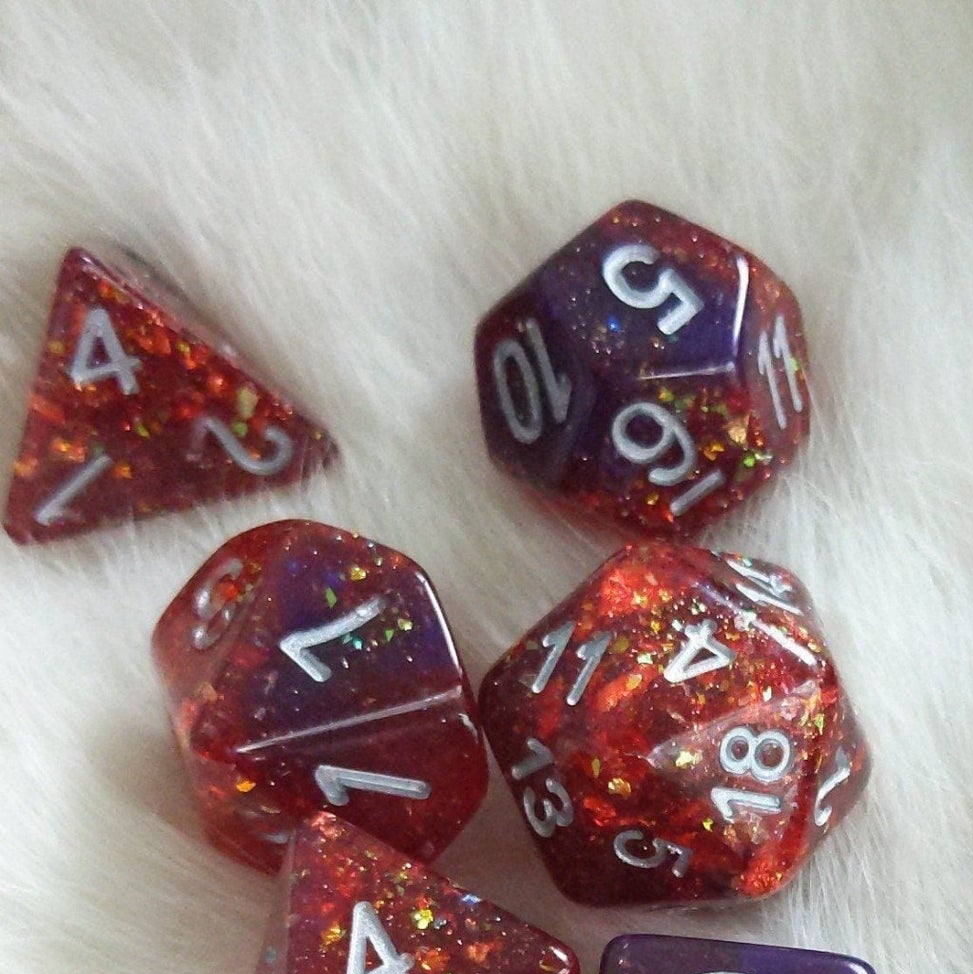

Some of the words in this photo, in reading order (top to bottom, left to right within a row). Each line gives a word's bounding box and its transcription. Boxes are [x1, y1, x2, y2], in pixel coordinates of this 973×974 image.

[602, 243, 704, 336] 5
[64, 305, 142, 396] 4
[492, 317, 573, 445] 10
[756, 314, 803, 431] 11
[531, 620, 613, 706] 11
[663, 618, 736, 683] 4
[511, 737, 575, 838] 13
[710, 725, 791, 822] 18
[612, 829, 693, 878] 5
